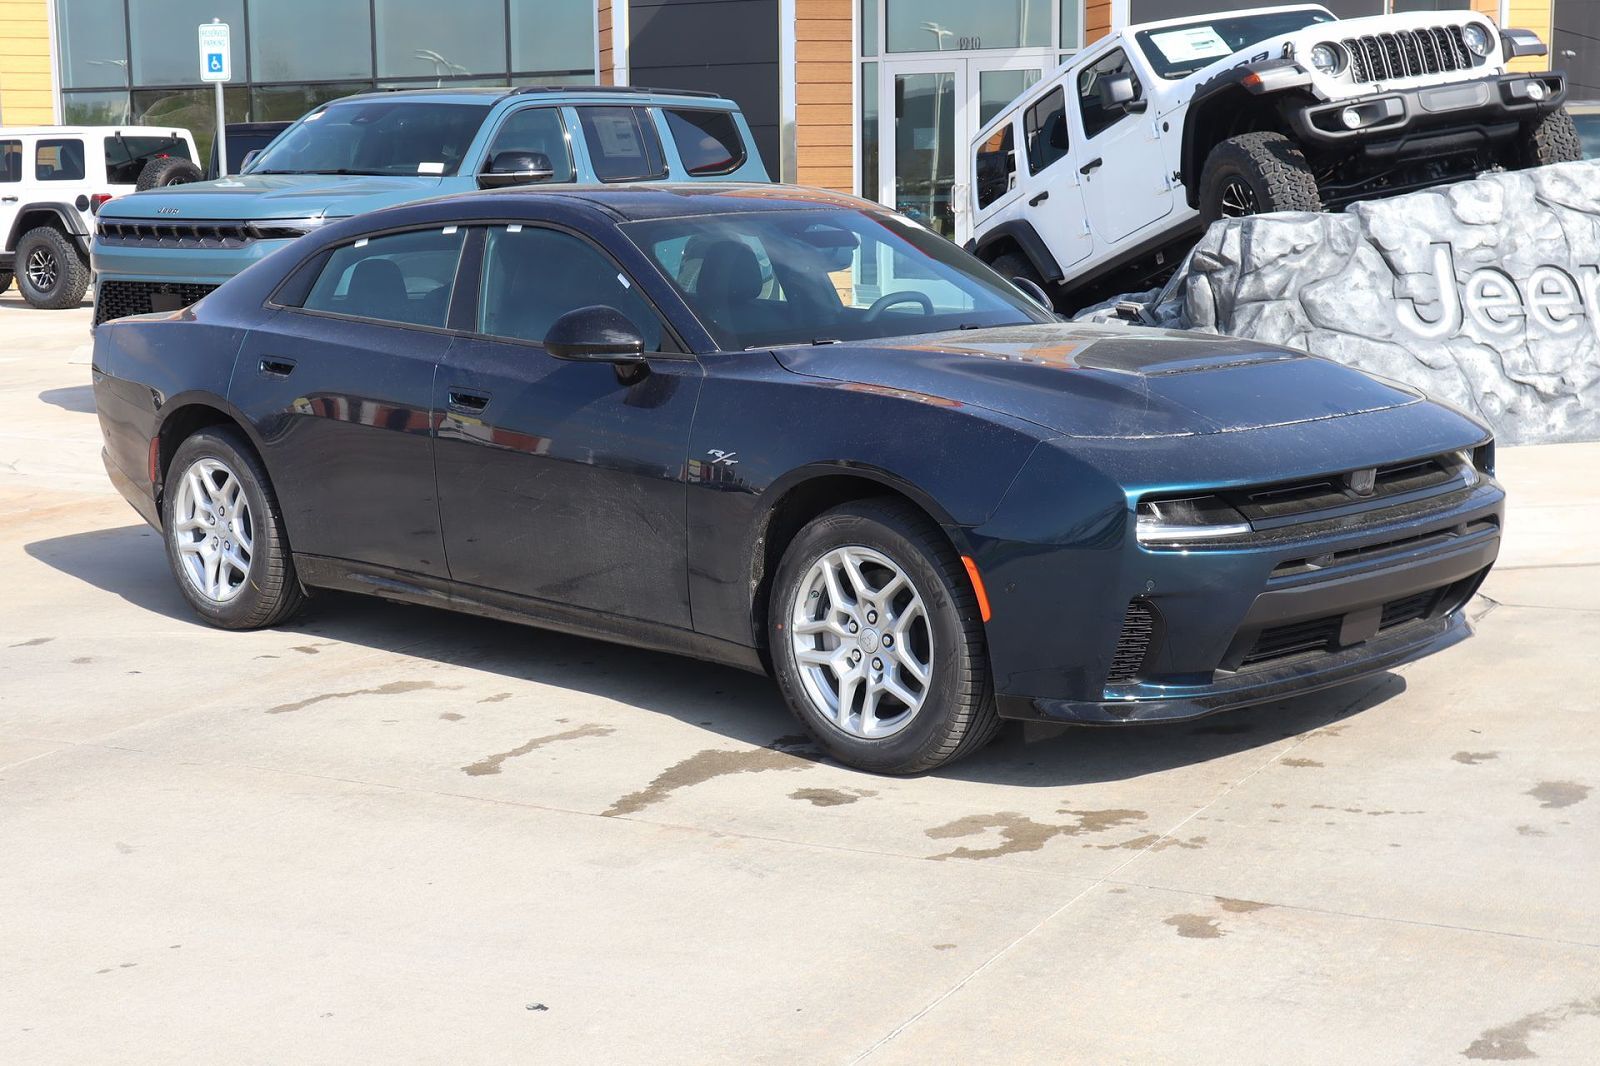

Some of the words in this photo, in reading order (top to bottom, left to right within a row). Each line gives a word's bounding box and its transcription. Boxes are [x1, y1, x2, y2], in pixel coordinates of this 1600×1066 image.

[1171, 170, 1182, 182] Je
[1394, 242, 1600, 340] Jee
[707, 449, 739, 465] R/T
